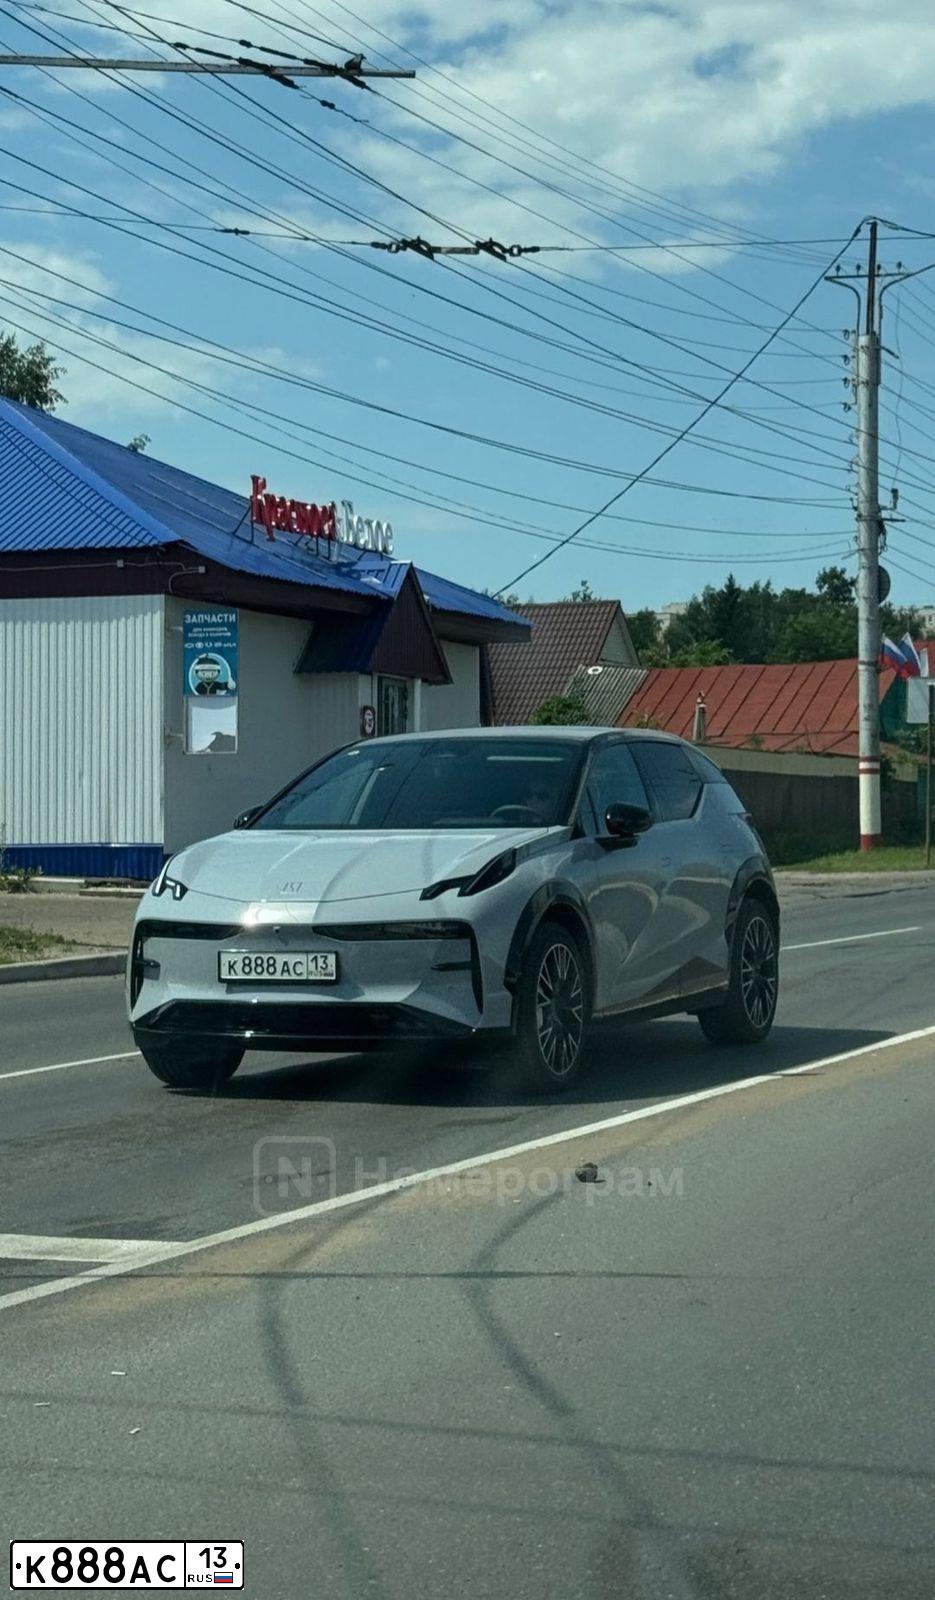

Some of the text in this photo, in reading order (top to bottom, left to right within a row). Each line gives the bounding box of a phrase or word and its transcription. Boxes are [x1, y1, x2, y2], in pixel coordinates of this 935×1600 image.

[185, 613, 237, 624] ЗАПЧАСТИ
[227, 955, 328, 976] К888АС 13
